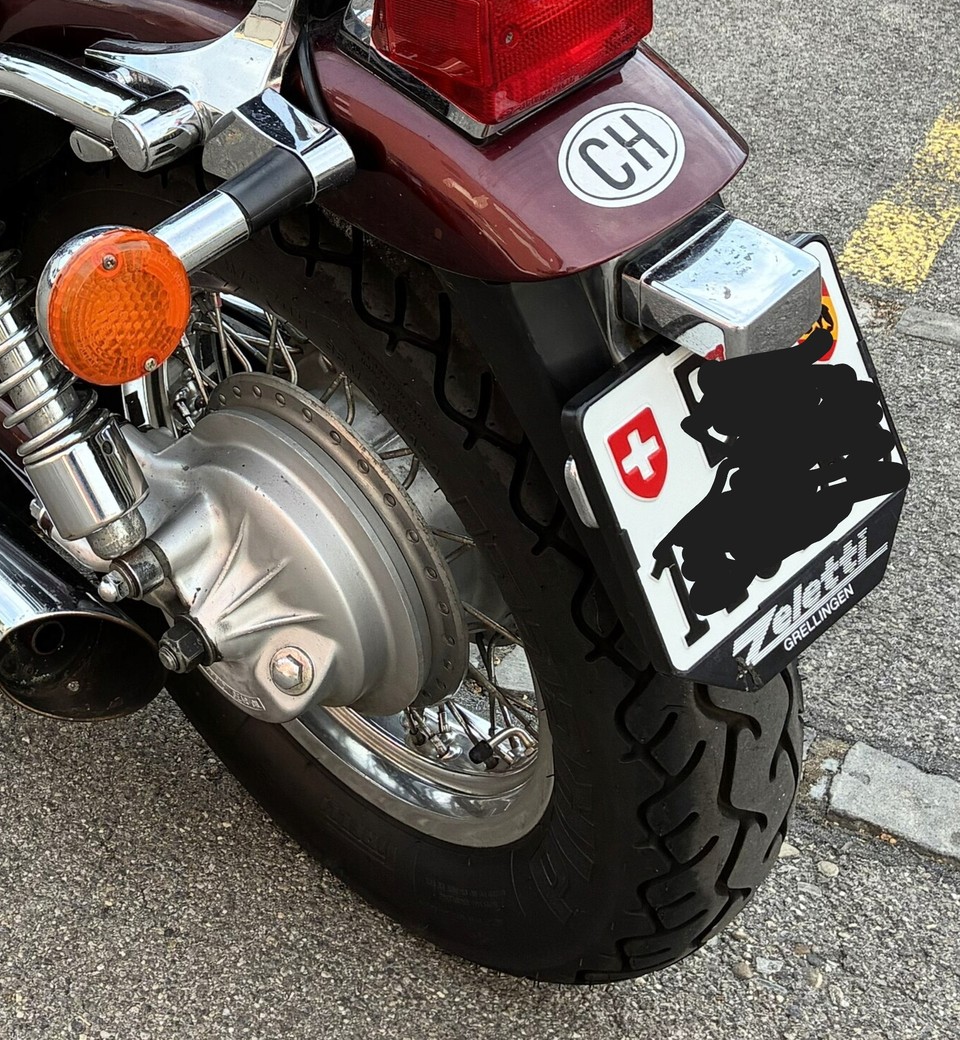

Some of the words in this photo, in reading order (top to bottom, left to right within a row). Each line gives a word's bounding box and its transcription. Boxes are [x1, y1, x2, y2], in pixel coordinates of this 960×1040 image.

[578, 113, 670, 191] CH
[732, 526, 888, 667] Zeletti
[783, 583, 855, 652] GRELLINGEN
